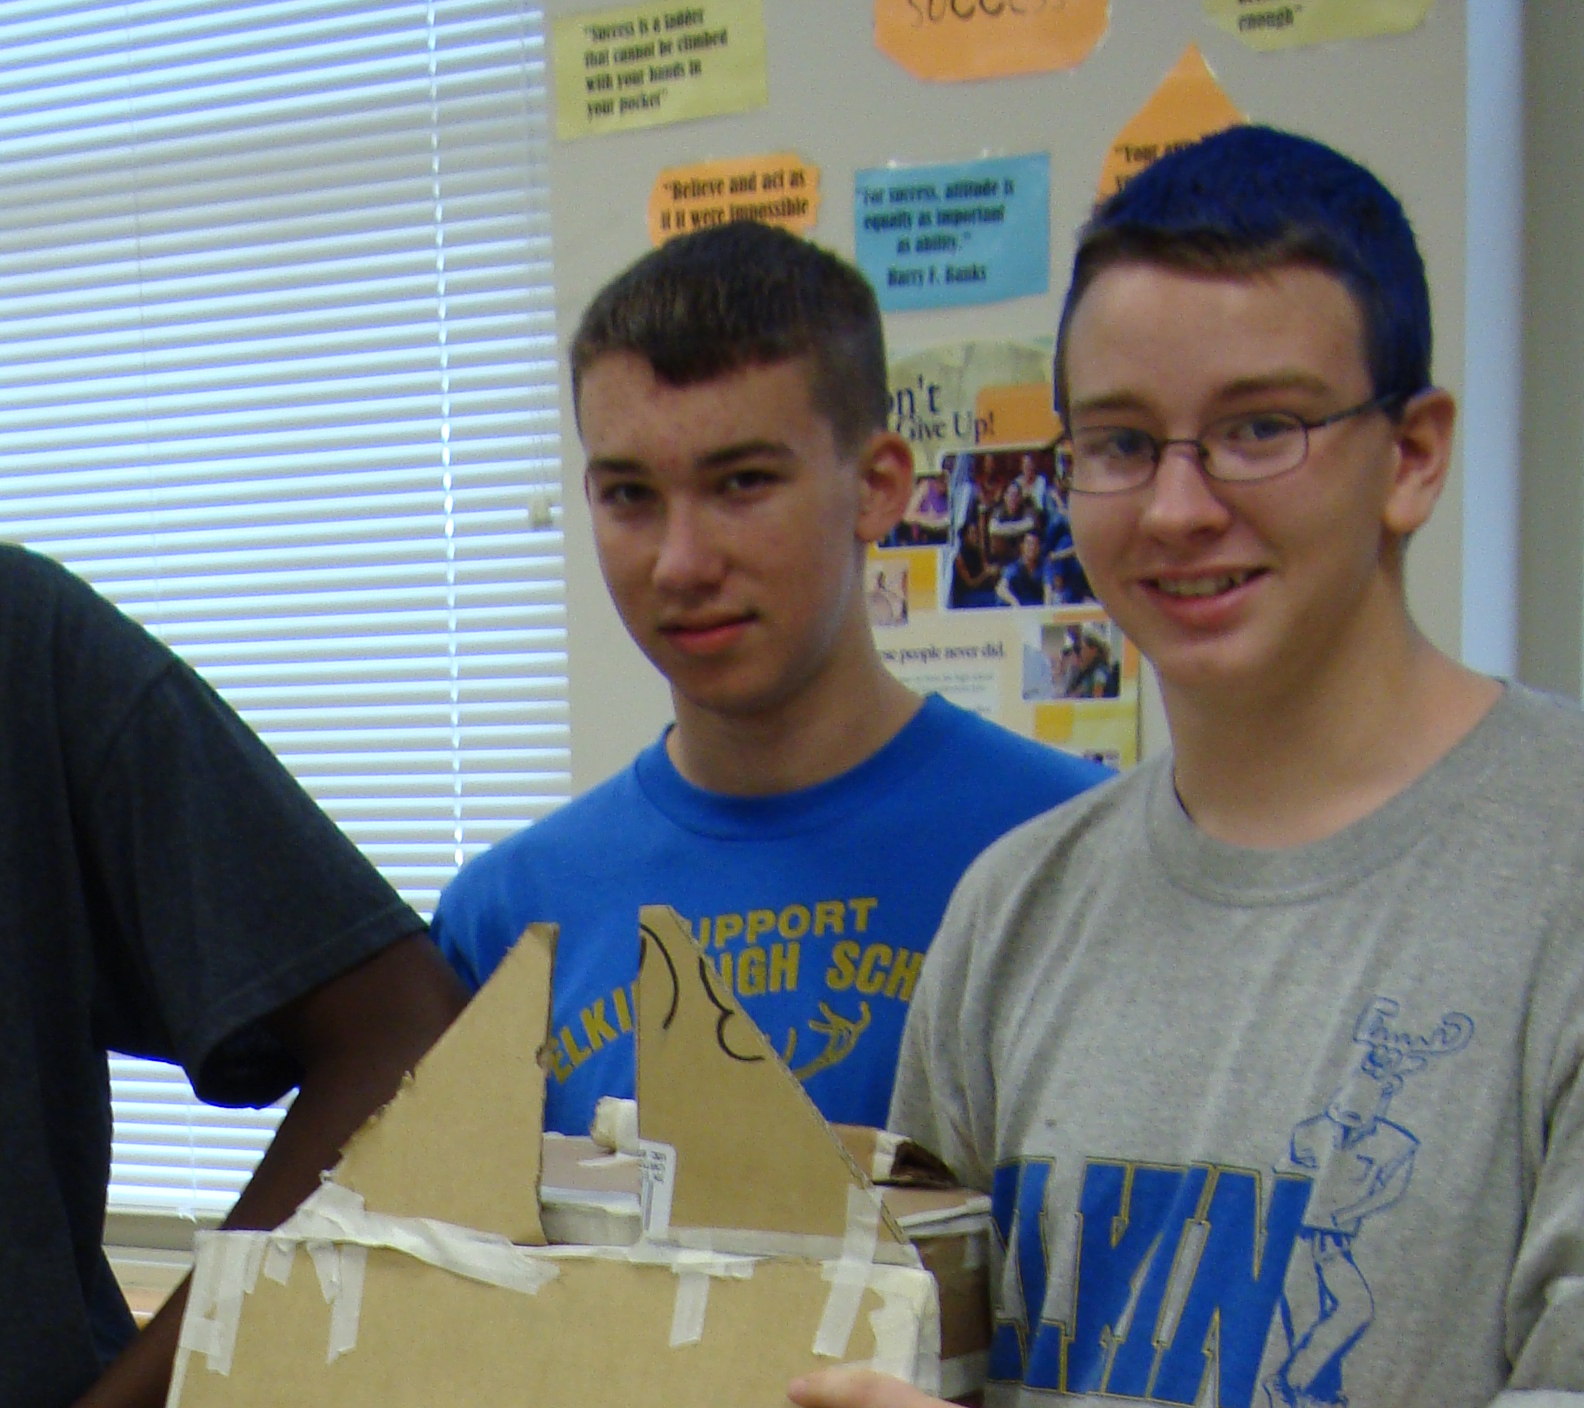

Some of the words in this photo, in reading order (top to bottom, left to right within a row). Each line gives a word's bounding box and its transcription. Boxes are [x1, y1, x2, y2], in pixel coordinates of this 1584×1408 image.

[584, 49, 610, 69] that
[614, 42, 655, 64] cannot
[659, 38, 673, 58] be
[677, 27, 728, 52] climbed
[585, 72, 613, 93] with
[618, 69, 644, 90] your
[649, 61, 685, 83] hands
[689, 58, 702, 76] in
[587, 97, 614, 123] your
[730, 170, 757, 194] and
[762, 168, 784, 190] act
[789, 168, 806, 188] as
[945, 177, 999, 199] attitude
[1003, 176, 1015, 196] is
[690, 206, 724, 227] were
[864, 210, 913, 233] equally
[918, 209, 932, 228] as
[935, 203, 1006, 228] important
[897, 236, 910, 255] as
[547, 980, 641, 1085] ELKI
[719, 941, 802, 996] IGH
